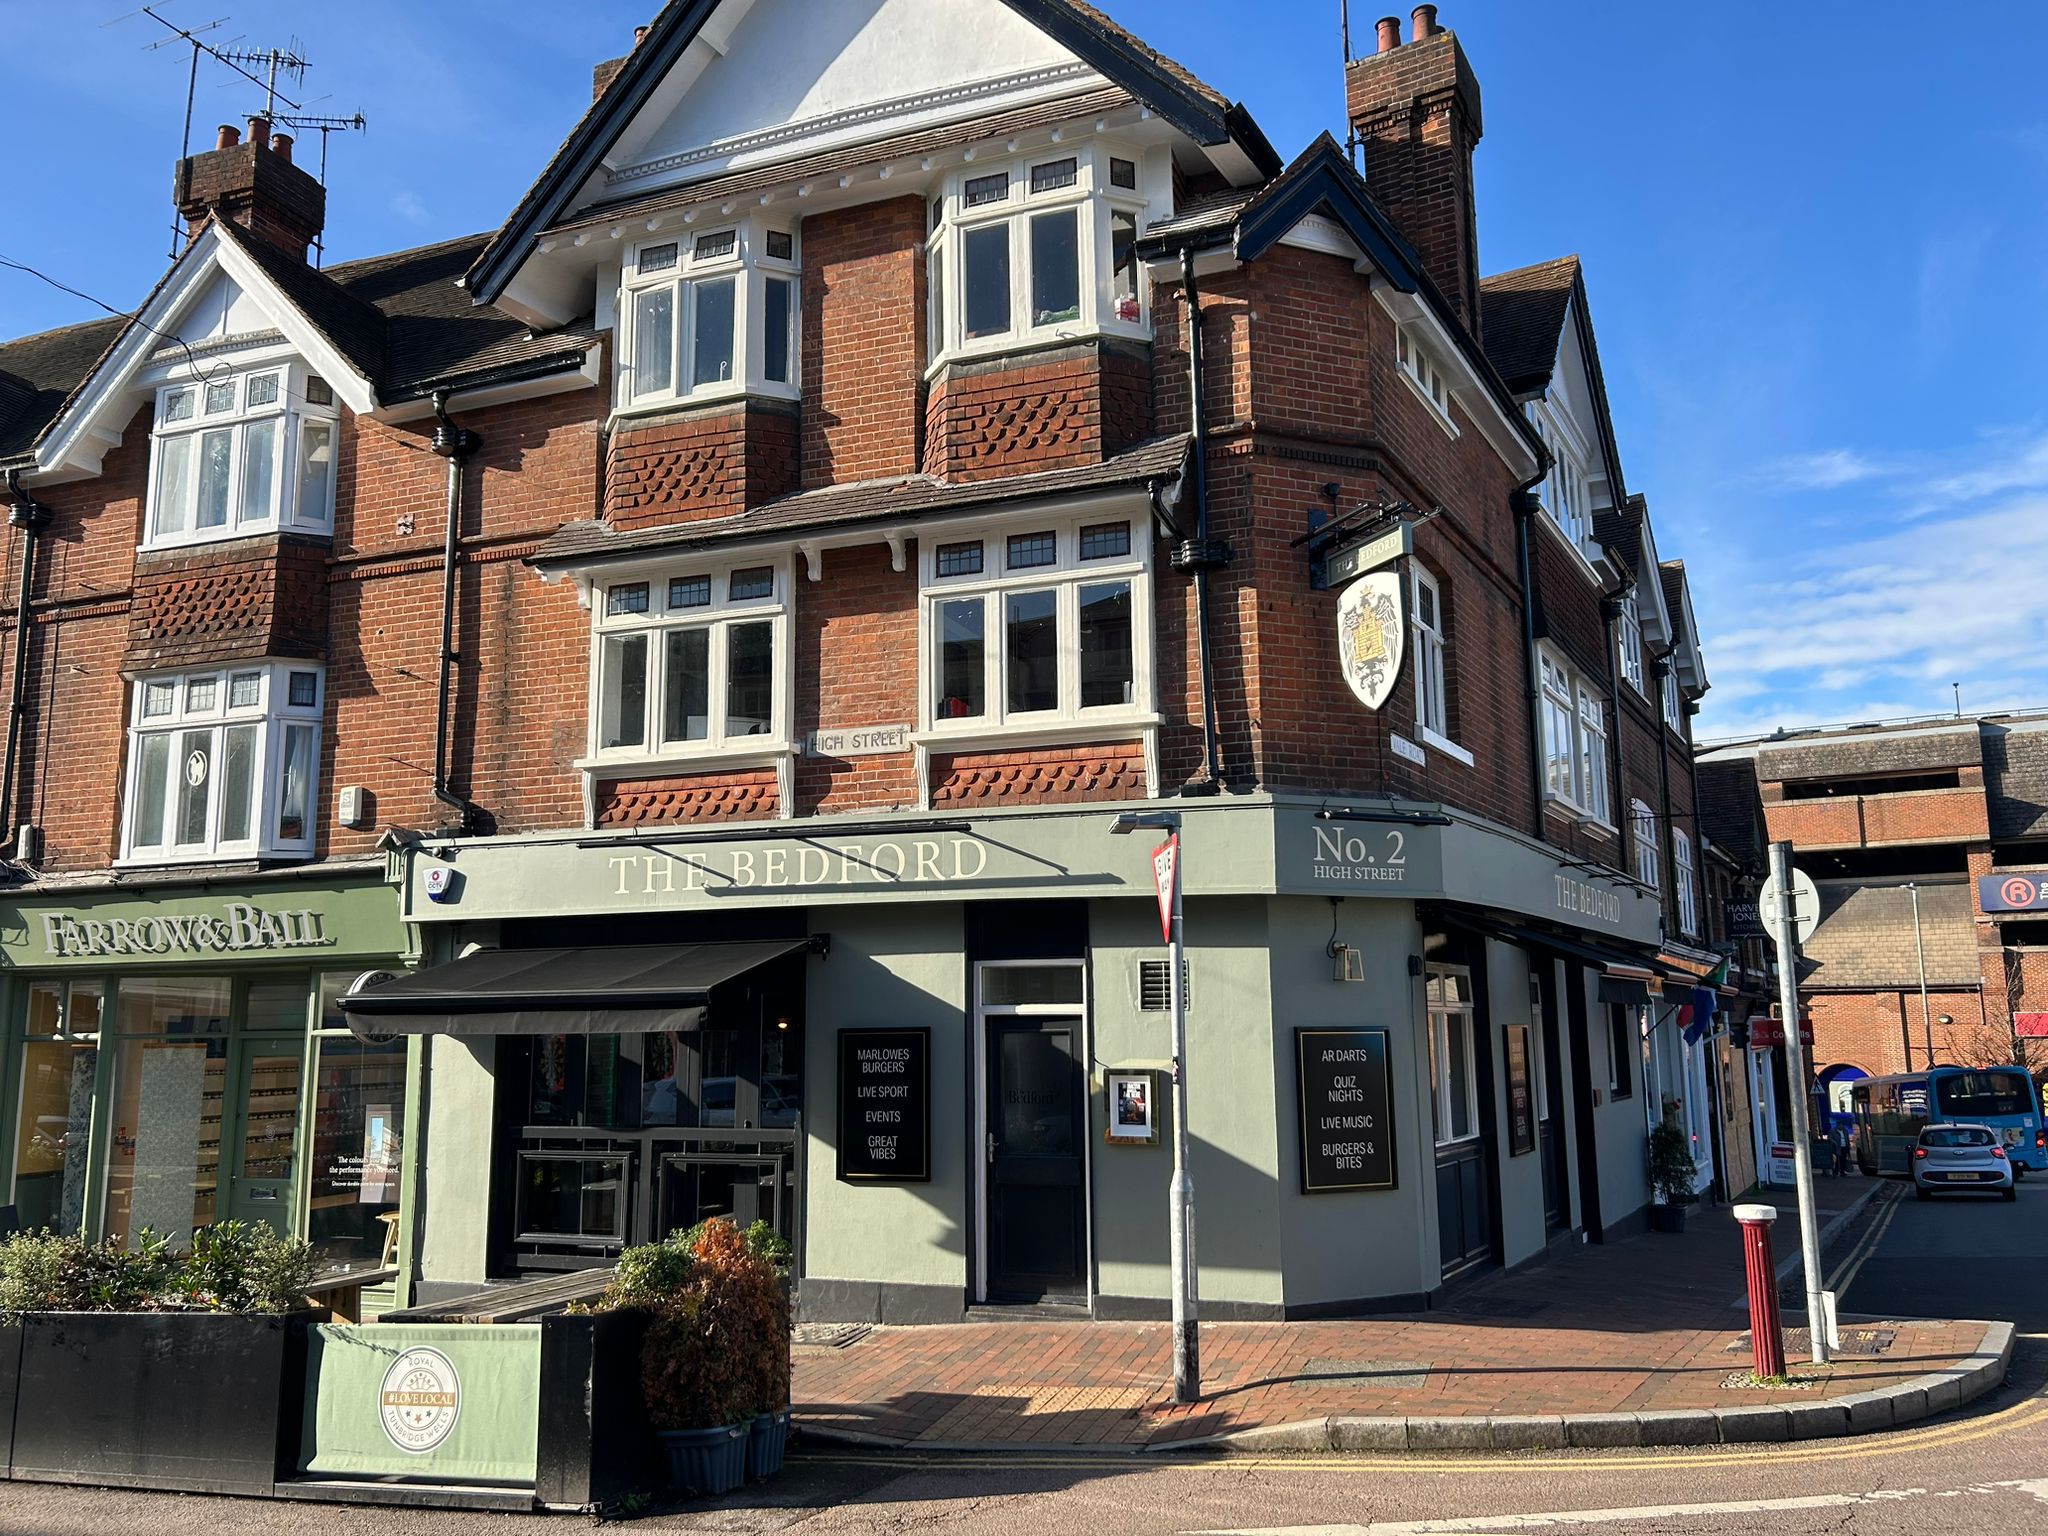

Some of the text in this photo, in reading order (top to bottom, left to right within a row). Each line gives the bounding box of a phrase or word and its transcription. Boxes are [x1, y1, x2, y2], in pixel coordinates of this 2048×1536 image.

[810, 731, 905, 752] HIGH STREET
[1312, 826, 1406, 864] No. 2
[609, 838, 988, 896] THE BEDFORD
[1158, 850, 1171, 877] GIVE
[1314, 865, 1405, 880] HIGH STREET
[1554, 873, 1621, 923] THE BEDFORD
[1727, 903, 1760, 912] HARVE
[1773, 1030, 1810, 1039] Colls
[857, 1048, 910, 1060] MARLOWES
[1321, 1049, 1367, 1061] AR DARTS
[862, 1061, 905, 1073] BURGERS
[1333, 1075, 1357, 1089] QUIZ
[857, 1085, 909, 1098] LIVE SPORT
[1328, 1089, 1364, 1102] NIGHTS
[865, 1110, 901, 1122] EVENTS
[1321, 1114, 1373, 1129] LIVE MUSIC
[868, 1135, 898, 1147] GREAT
[869, 1147, 897, 1160] VIBES
[1322, 1141, 1374, 1156] BURGERS &
[329, 1165, 338, 1173] the
[1336, 1156, 1363, 1169] BITES
[408, 1357, 434, 1368] ROYAL
[388, 1393, 453, 1405] #LOVE LOCAL
[388, 1410, 449, 1442] TUNBRIDGE WELLS
